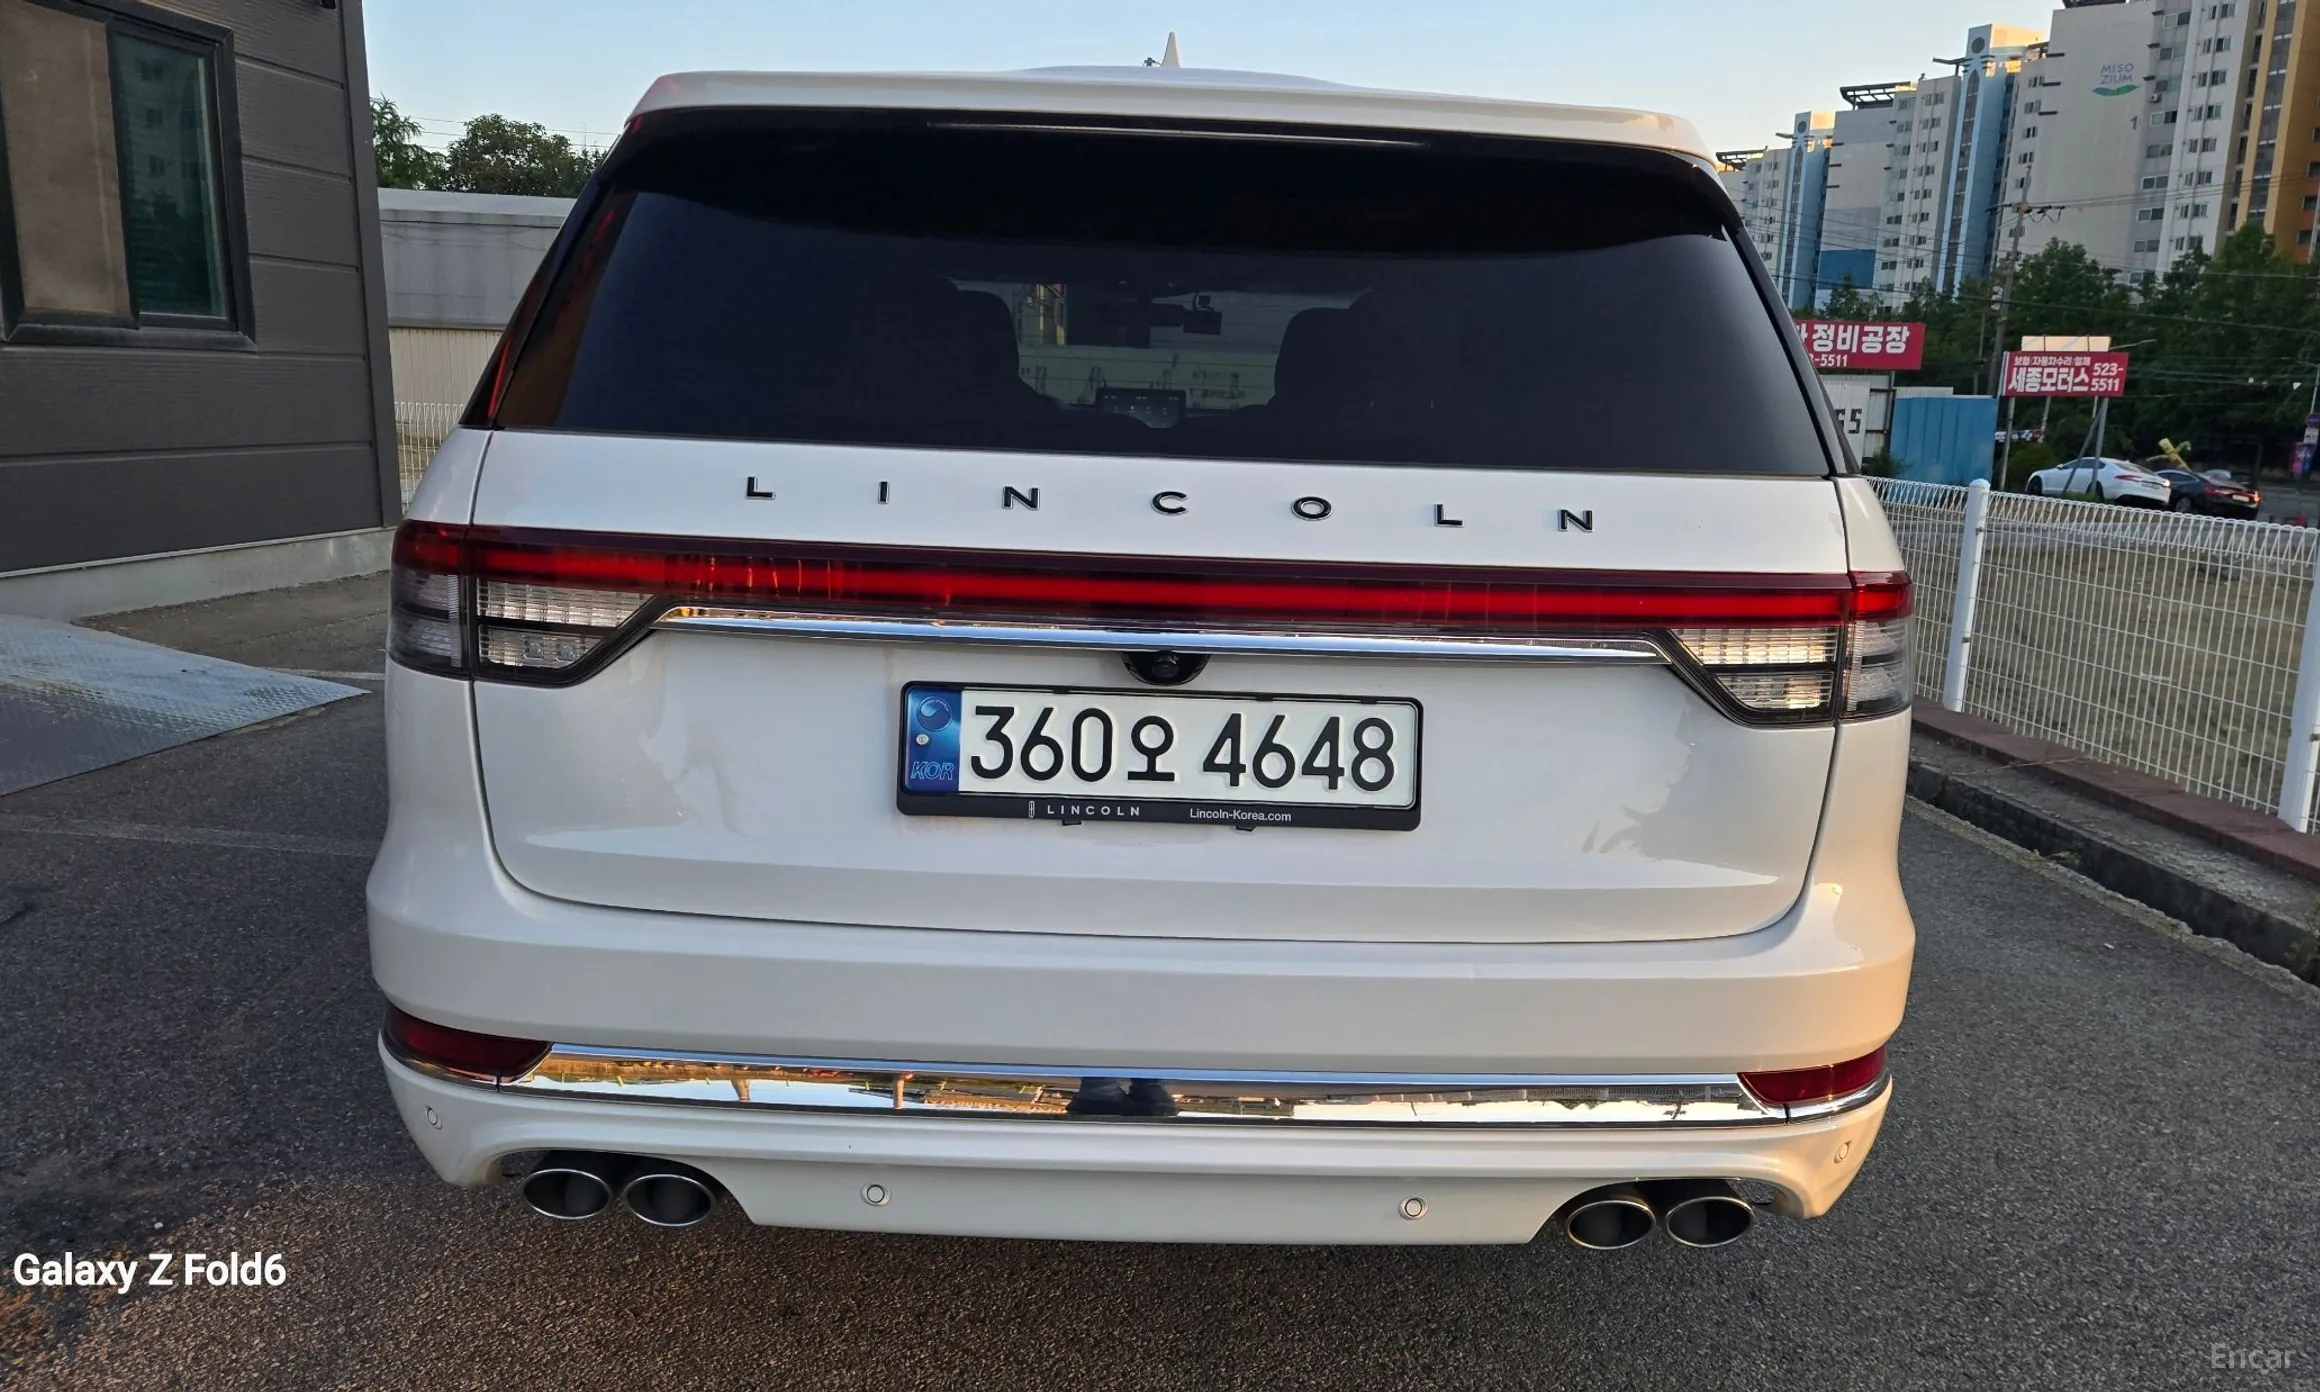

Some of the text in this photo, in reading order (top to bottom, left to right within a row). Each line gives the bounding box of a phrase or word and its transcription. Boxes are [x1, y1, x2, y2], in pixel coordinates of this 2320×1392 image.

[2101, 63, 2135, 74] MISO
[2101, 74, 2133, 84] ZIUM
[2092, 362, 2124, 376] 523-
[2008, 366, 2089, 392] 세종모터스
[2090, 378, 2119, 392] 5511
[746, 475, 1595, 532] LINCOLN
[971, 705, 1395, 792] 360오 4648
[911, 761, 955, 781] KOR
[1047, 804, 1292, 822] LINCOLN Lincoln-Korea.com
